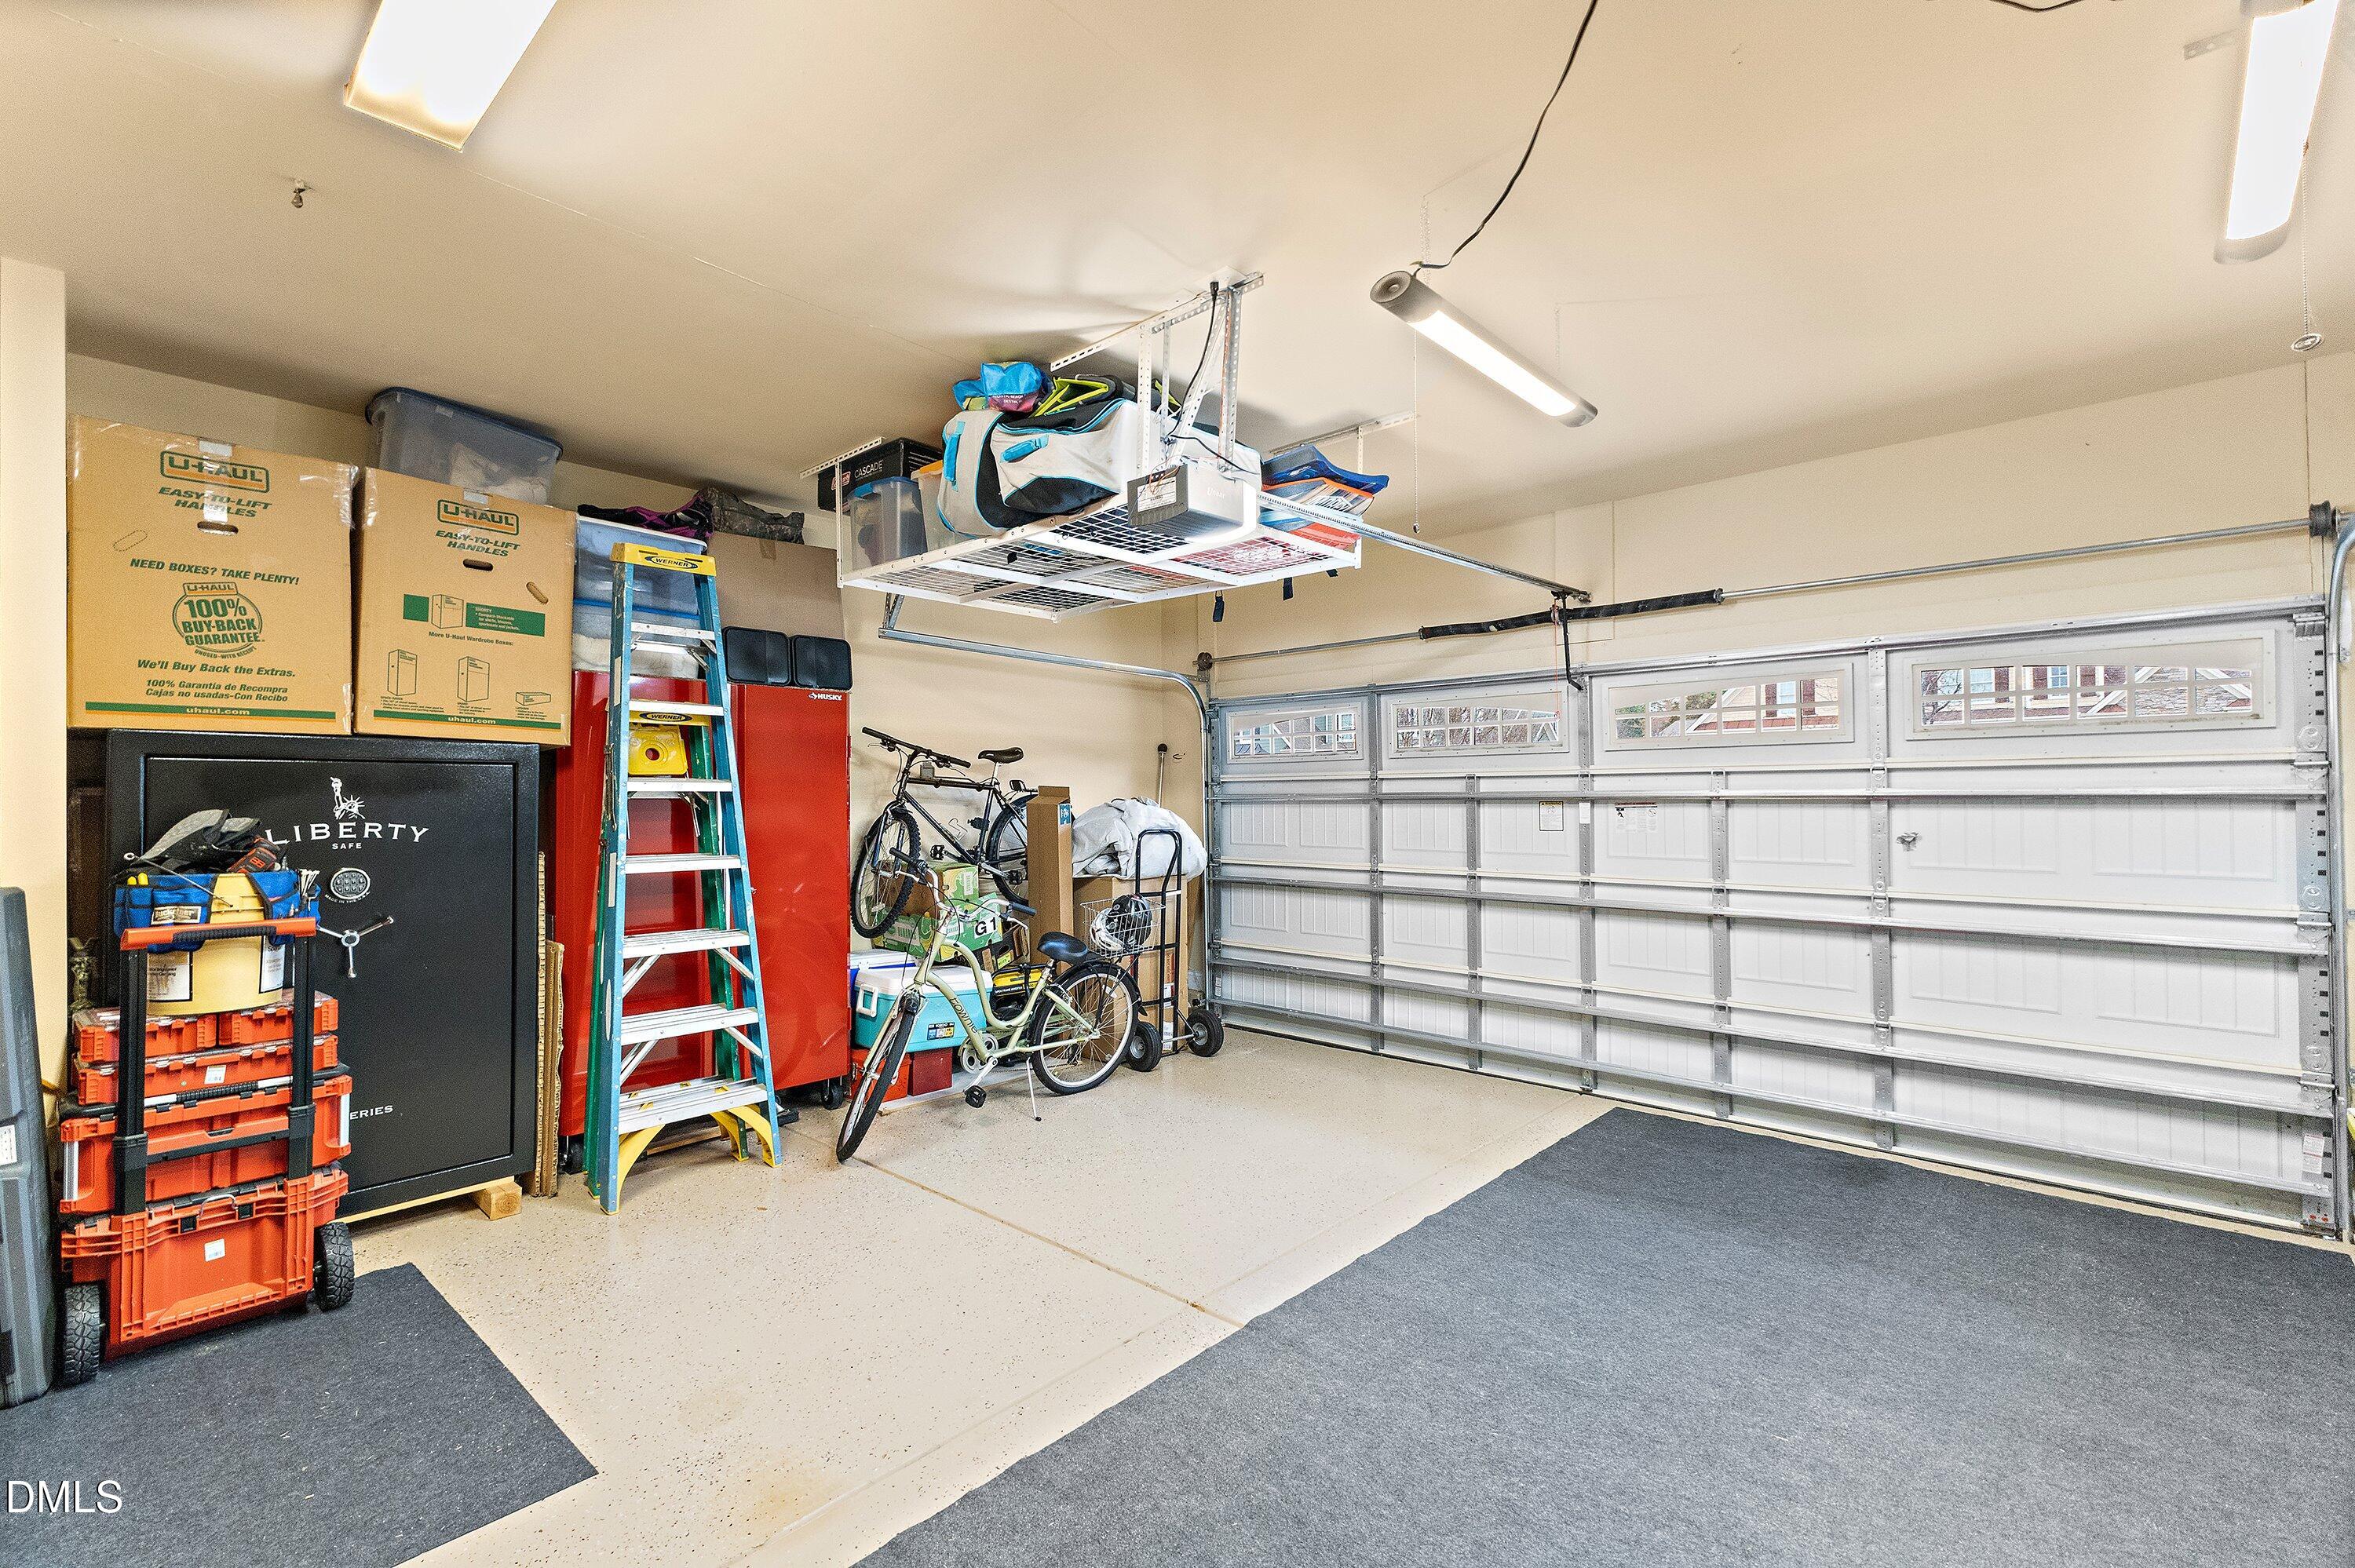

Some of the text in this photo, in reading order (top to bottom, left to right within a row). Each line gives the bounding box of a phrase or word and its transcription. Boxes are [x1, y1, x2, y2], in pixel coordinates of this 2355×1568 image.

[168, 455, 263, 483] U-HAUL
[854, 459, 884, 479] CASCADE
[443, 503, 514, 527] U-HAUL
[436, 530, 521, 550] EASY-TO-LIFT
[447, 541, 509, 556] HANDLES
[655, 558, 689, 567] WERNER
[130, 558, 300, 585] NEED BOXES? TAKE PLENTY!
[187, 583, 236, 592] U-HAUL
[183, 598, 247, 618] 100%
[181, 618, 257, 633] BUY-BACK
[137, 658, 296, 677] We'll Buy Back the Extras.
[145, 688, 175, 698] Cajas
[146, 679, 175, 687] 100%
[239, 684, 288, 695] Recompra
[447, 716, 496, 724] uhaul.com
[265, 821, 429, 845] LIBERTY
[324, 894, 338, 903] MADE
[349, 1105, 393, 1120] ERIES
